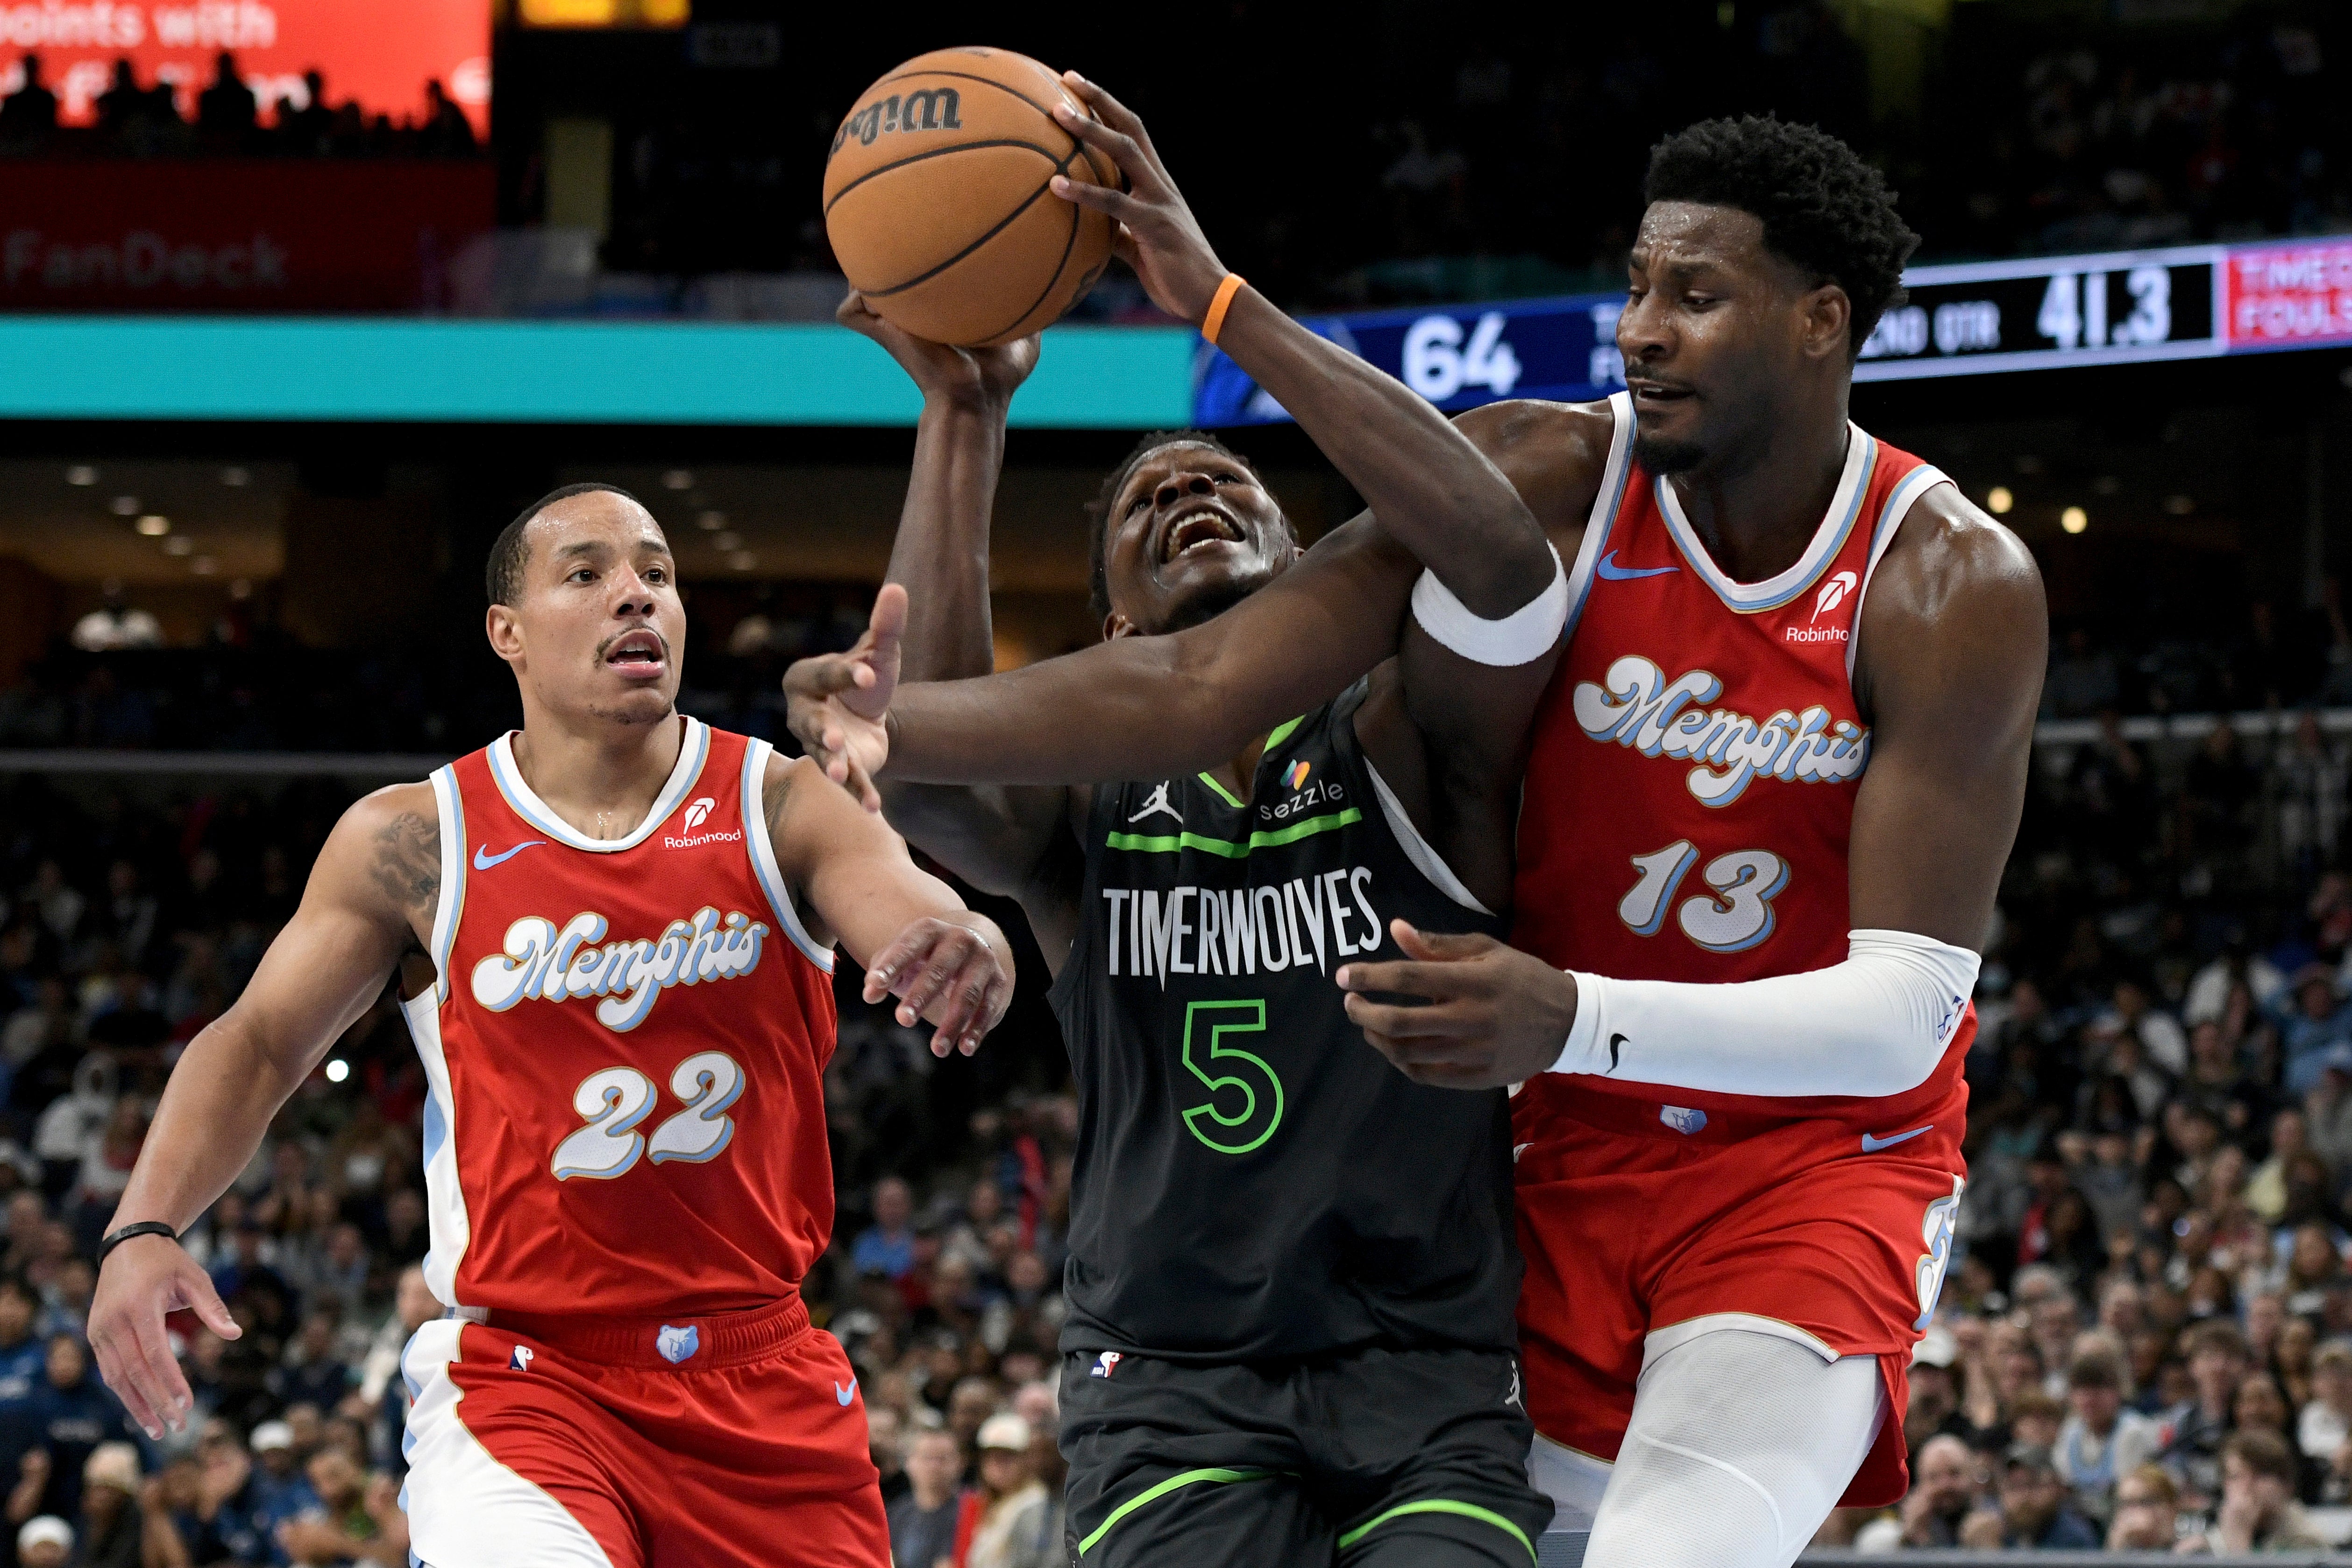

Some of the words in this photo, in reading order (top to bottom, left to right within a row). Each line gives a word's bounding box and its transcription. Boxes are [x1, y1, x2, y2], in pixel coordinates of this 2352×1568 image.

[152, 0, 277, 47] with
[4, 228, 291, 286] FanDeck
[2037, 268, 2172, 349] 41.3
[1402, 311, 1523, 401] 64
[1786, 626, 1849, 642] Robinho
[1573, 655, 1872, 808] Memphis
[664, 829, 741, 849] Robinhood
[1260, 779, 1343, 820] sezzle
[1617, 839, 1791, 954] 13
[471, 906, 770, 1033] Memphis
[550, 1050, 746, 1182] 22
[1182, 999, 1284, 1154] 5
[1092, 1367, 1104, 1376] NBA
